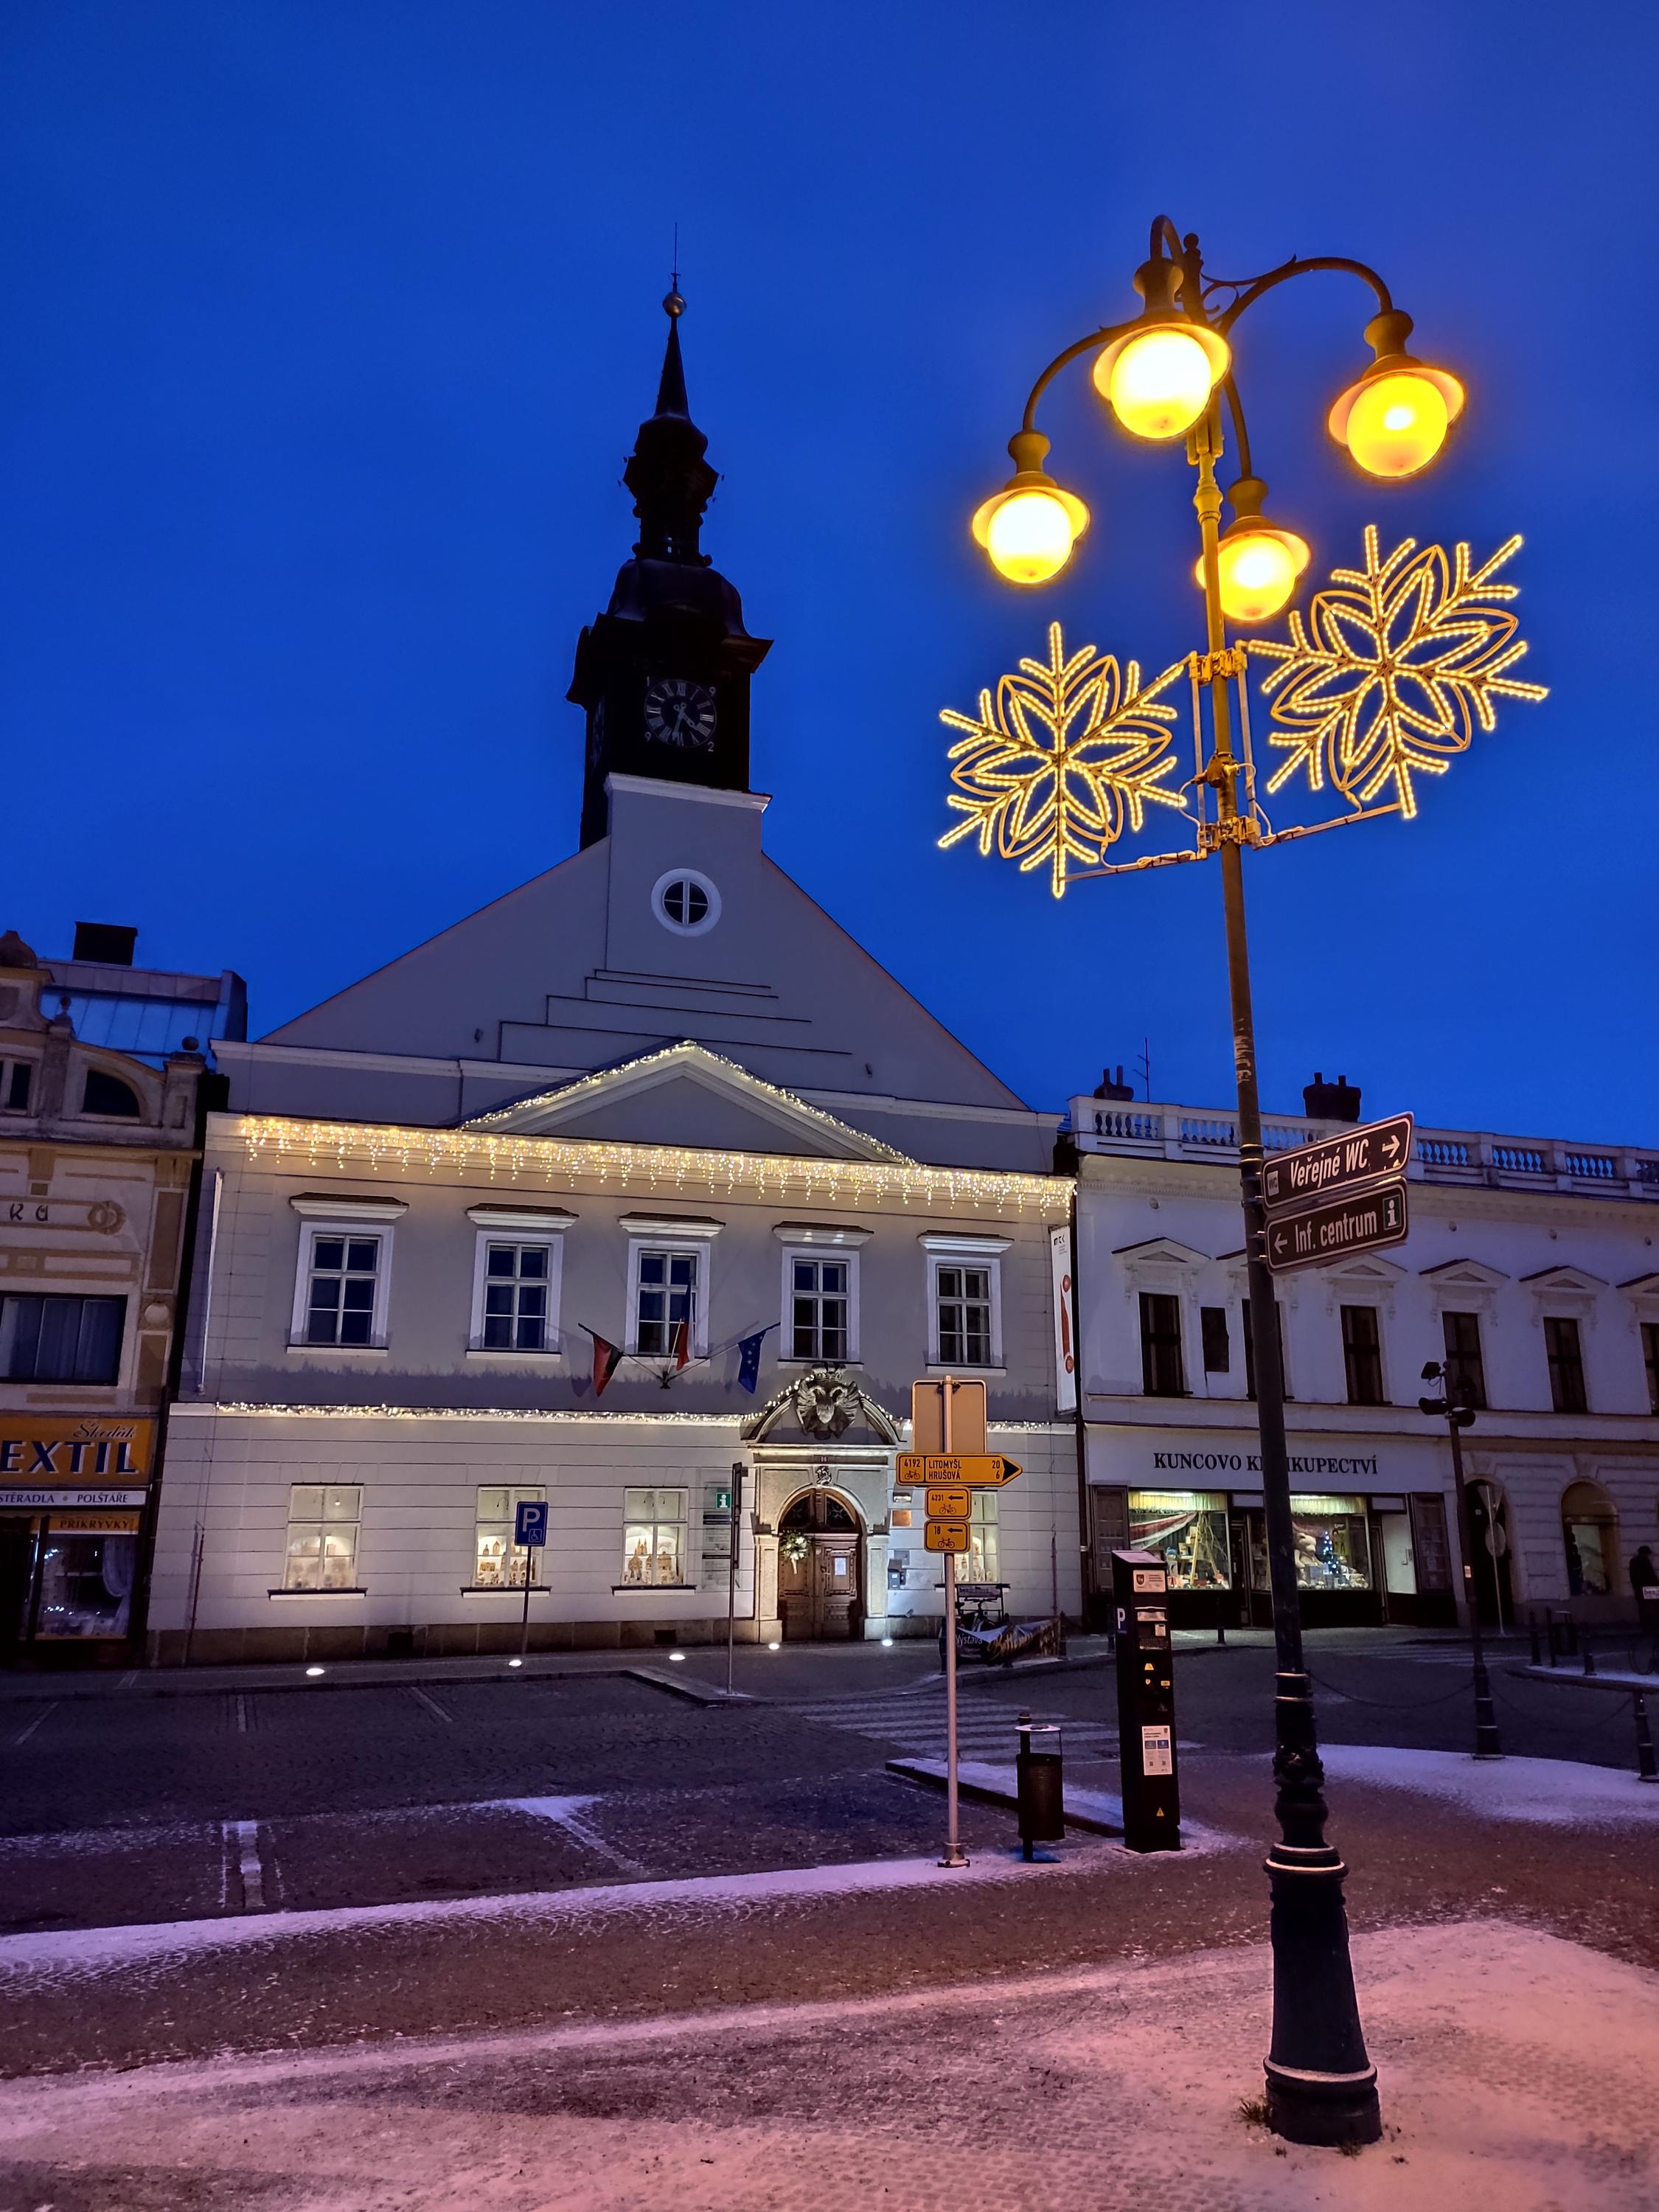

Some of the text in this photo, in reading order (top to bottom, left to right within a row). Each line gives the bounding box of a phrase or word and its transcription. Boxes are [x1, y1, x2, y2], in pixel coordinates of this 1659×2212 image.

[1290, 1138, 1369, 1189] Veřejné WC
[1295, 1210, 1377, 1253] Inf. centrum
[0, 1441, 140, 1474] EXTIL
[904, 1458, 920, 1468] 4192
[928, 1458, 1001, 1469] LITOMYŠL 20
[1153, 1453, 1378, 1474] KUNCOVO KKUPECTVÍ
[928, 1470, 1000, 1480] HRUŠOVÁ 6
[77, 1492, 128, 1503] POLŠTÁŘE
[523, 1508, 540, 1532] P
[933, 1526, 941, 1534] 18
[1117, 1607, 1126, 1630] P
